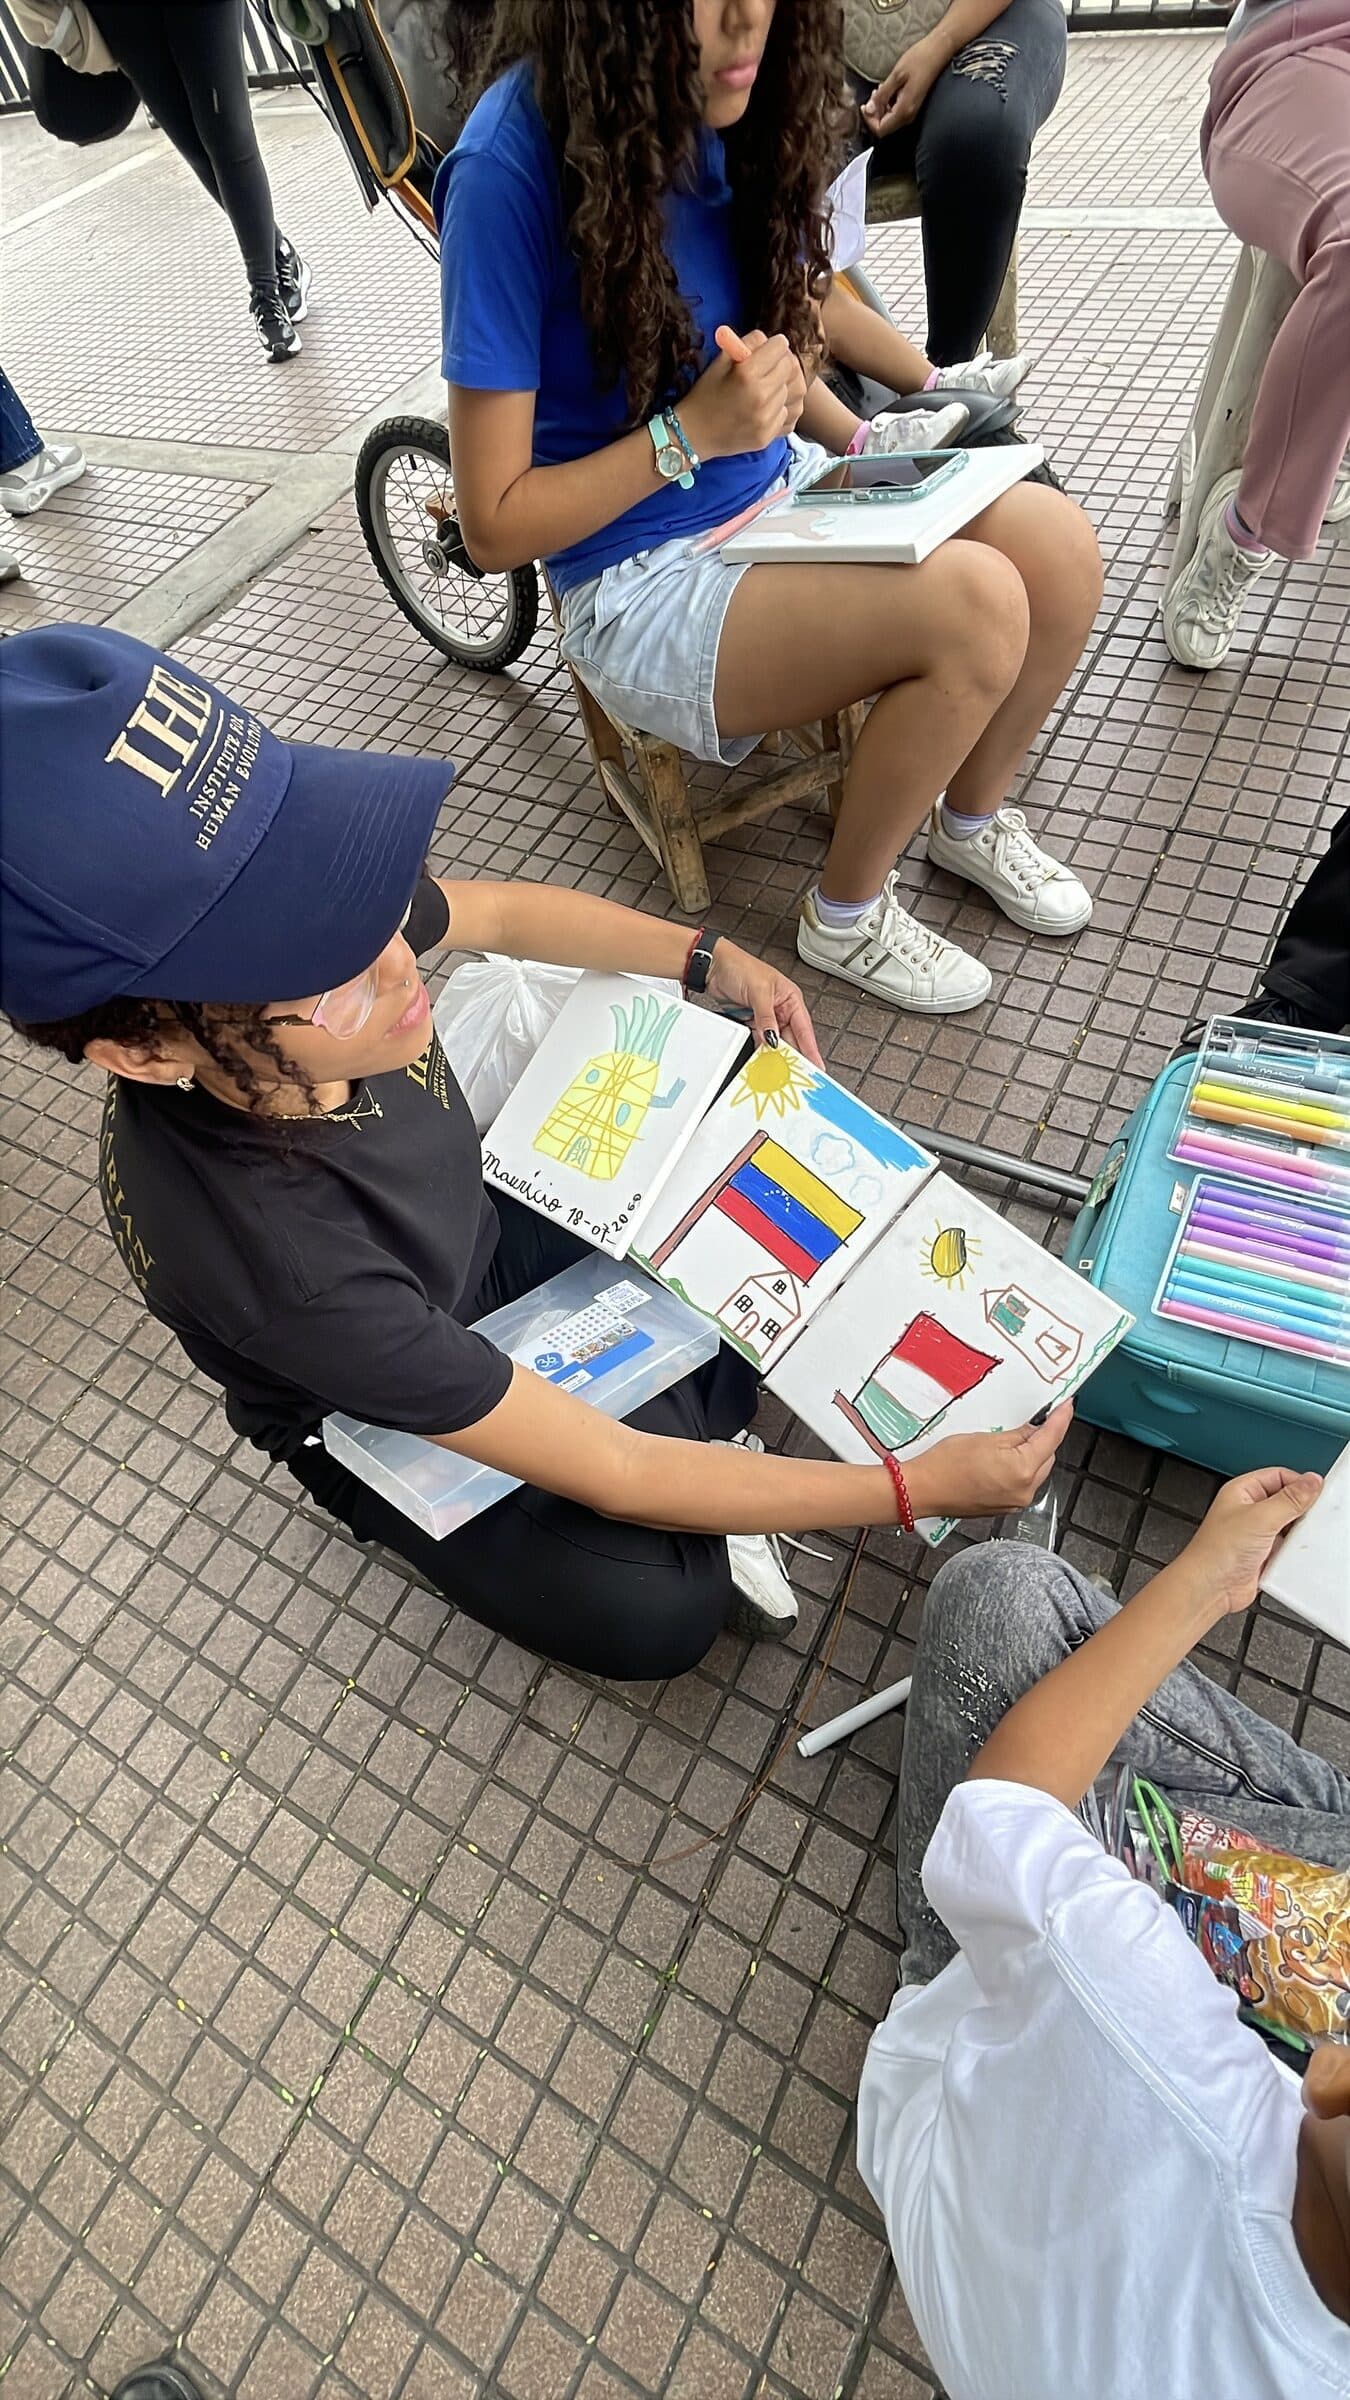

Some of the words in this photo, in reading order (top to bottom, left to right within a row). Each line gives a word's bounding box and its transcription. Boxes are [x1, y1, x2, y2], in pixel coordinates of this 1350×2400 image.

[104, 664, 212, 799] IHE
[189, 733, 240, 819] INSTITUTE
[195, 781, 242, 851] HUMAN
